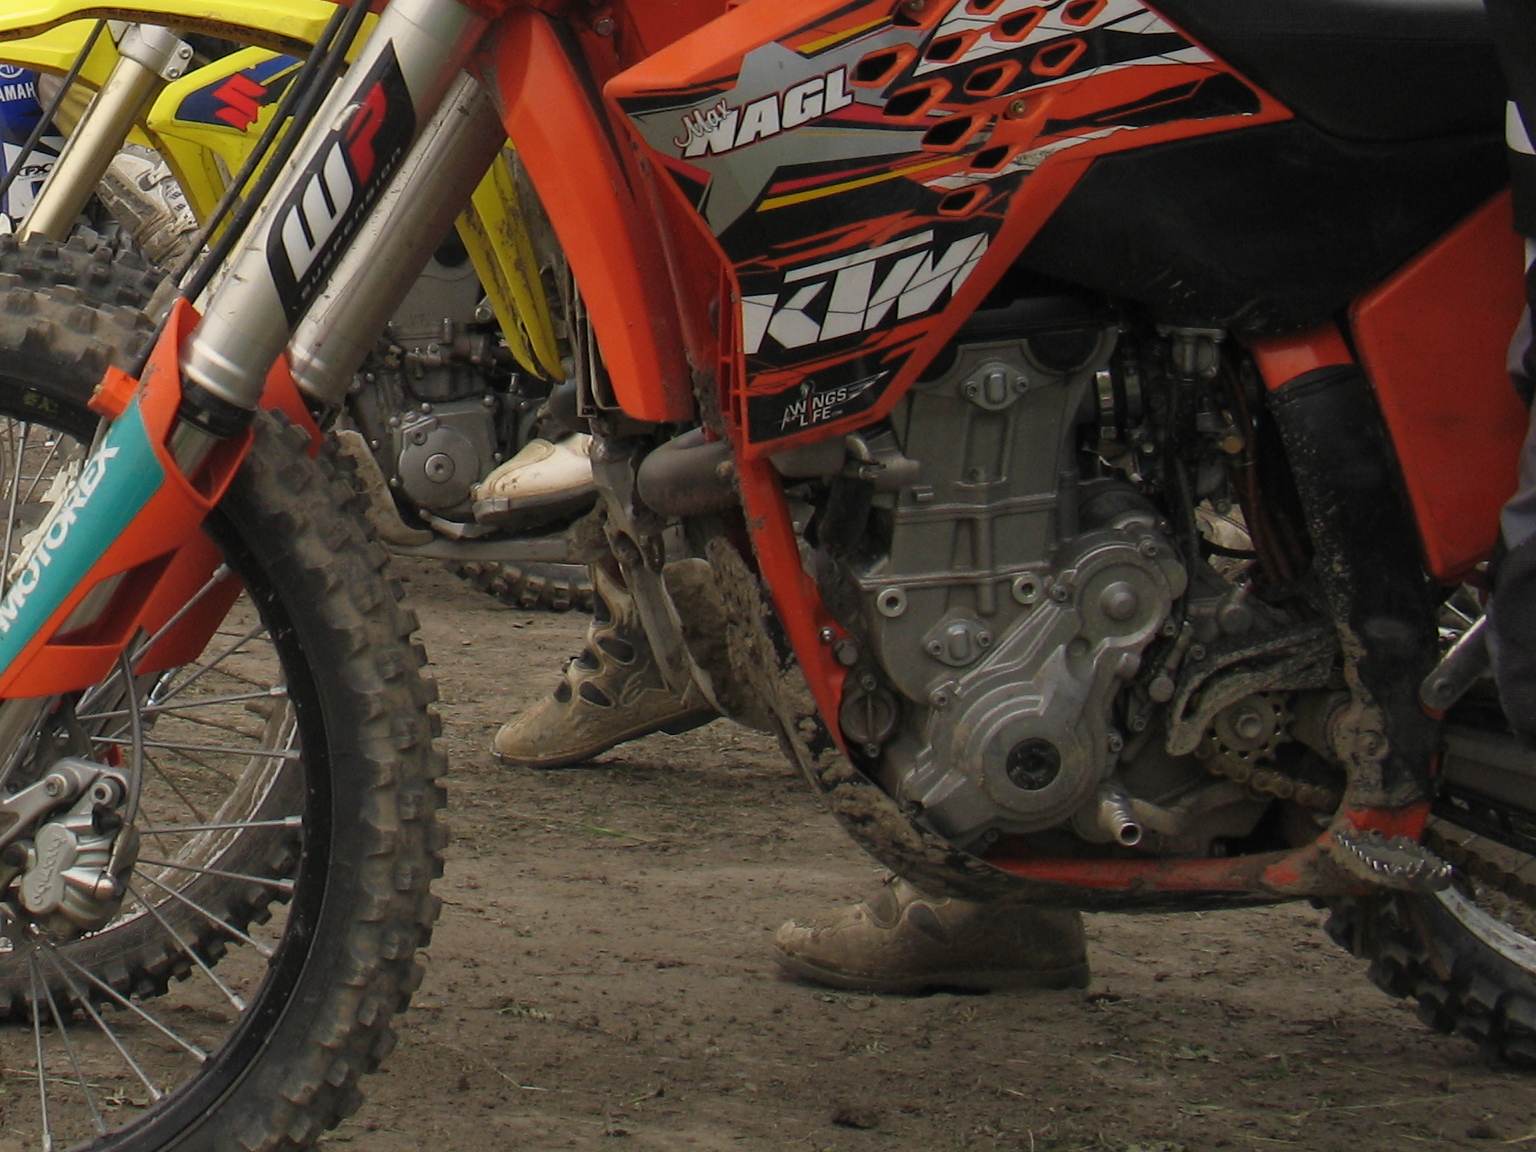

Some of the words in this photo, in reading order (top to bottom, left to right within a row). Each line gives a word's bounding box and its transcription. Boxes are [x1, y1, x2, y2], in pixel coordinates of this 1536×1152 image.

[674, 98, 732, 148] Max
[681, 64, 855, 160] NAGL
[741, 229, 989, 355] KTM
